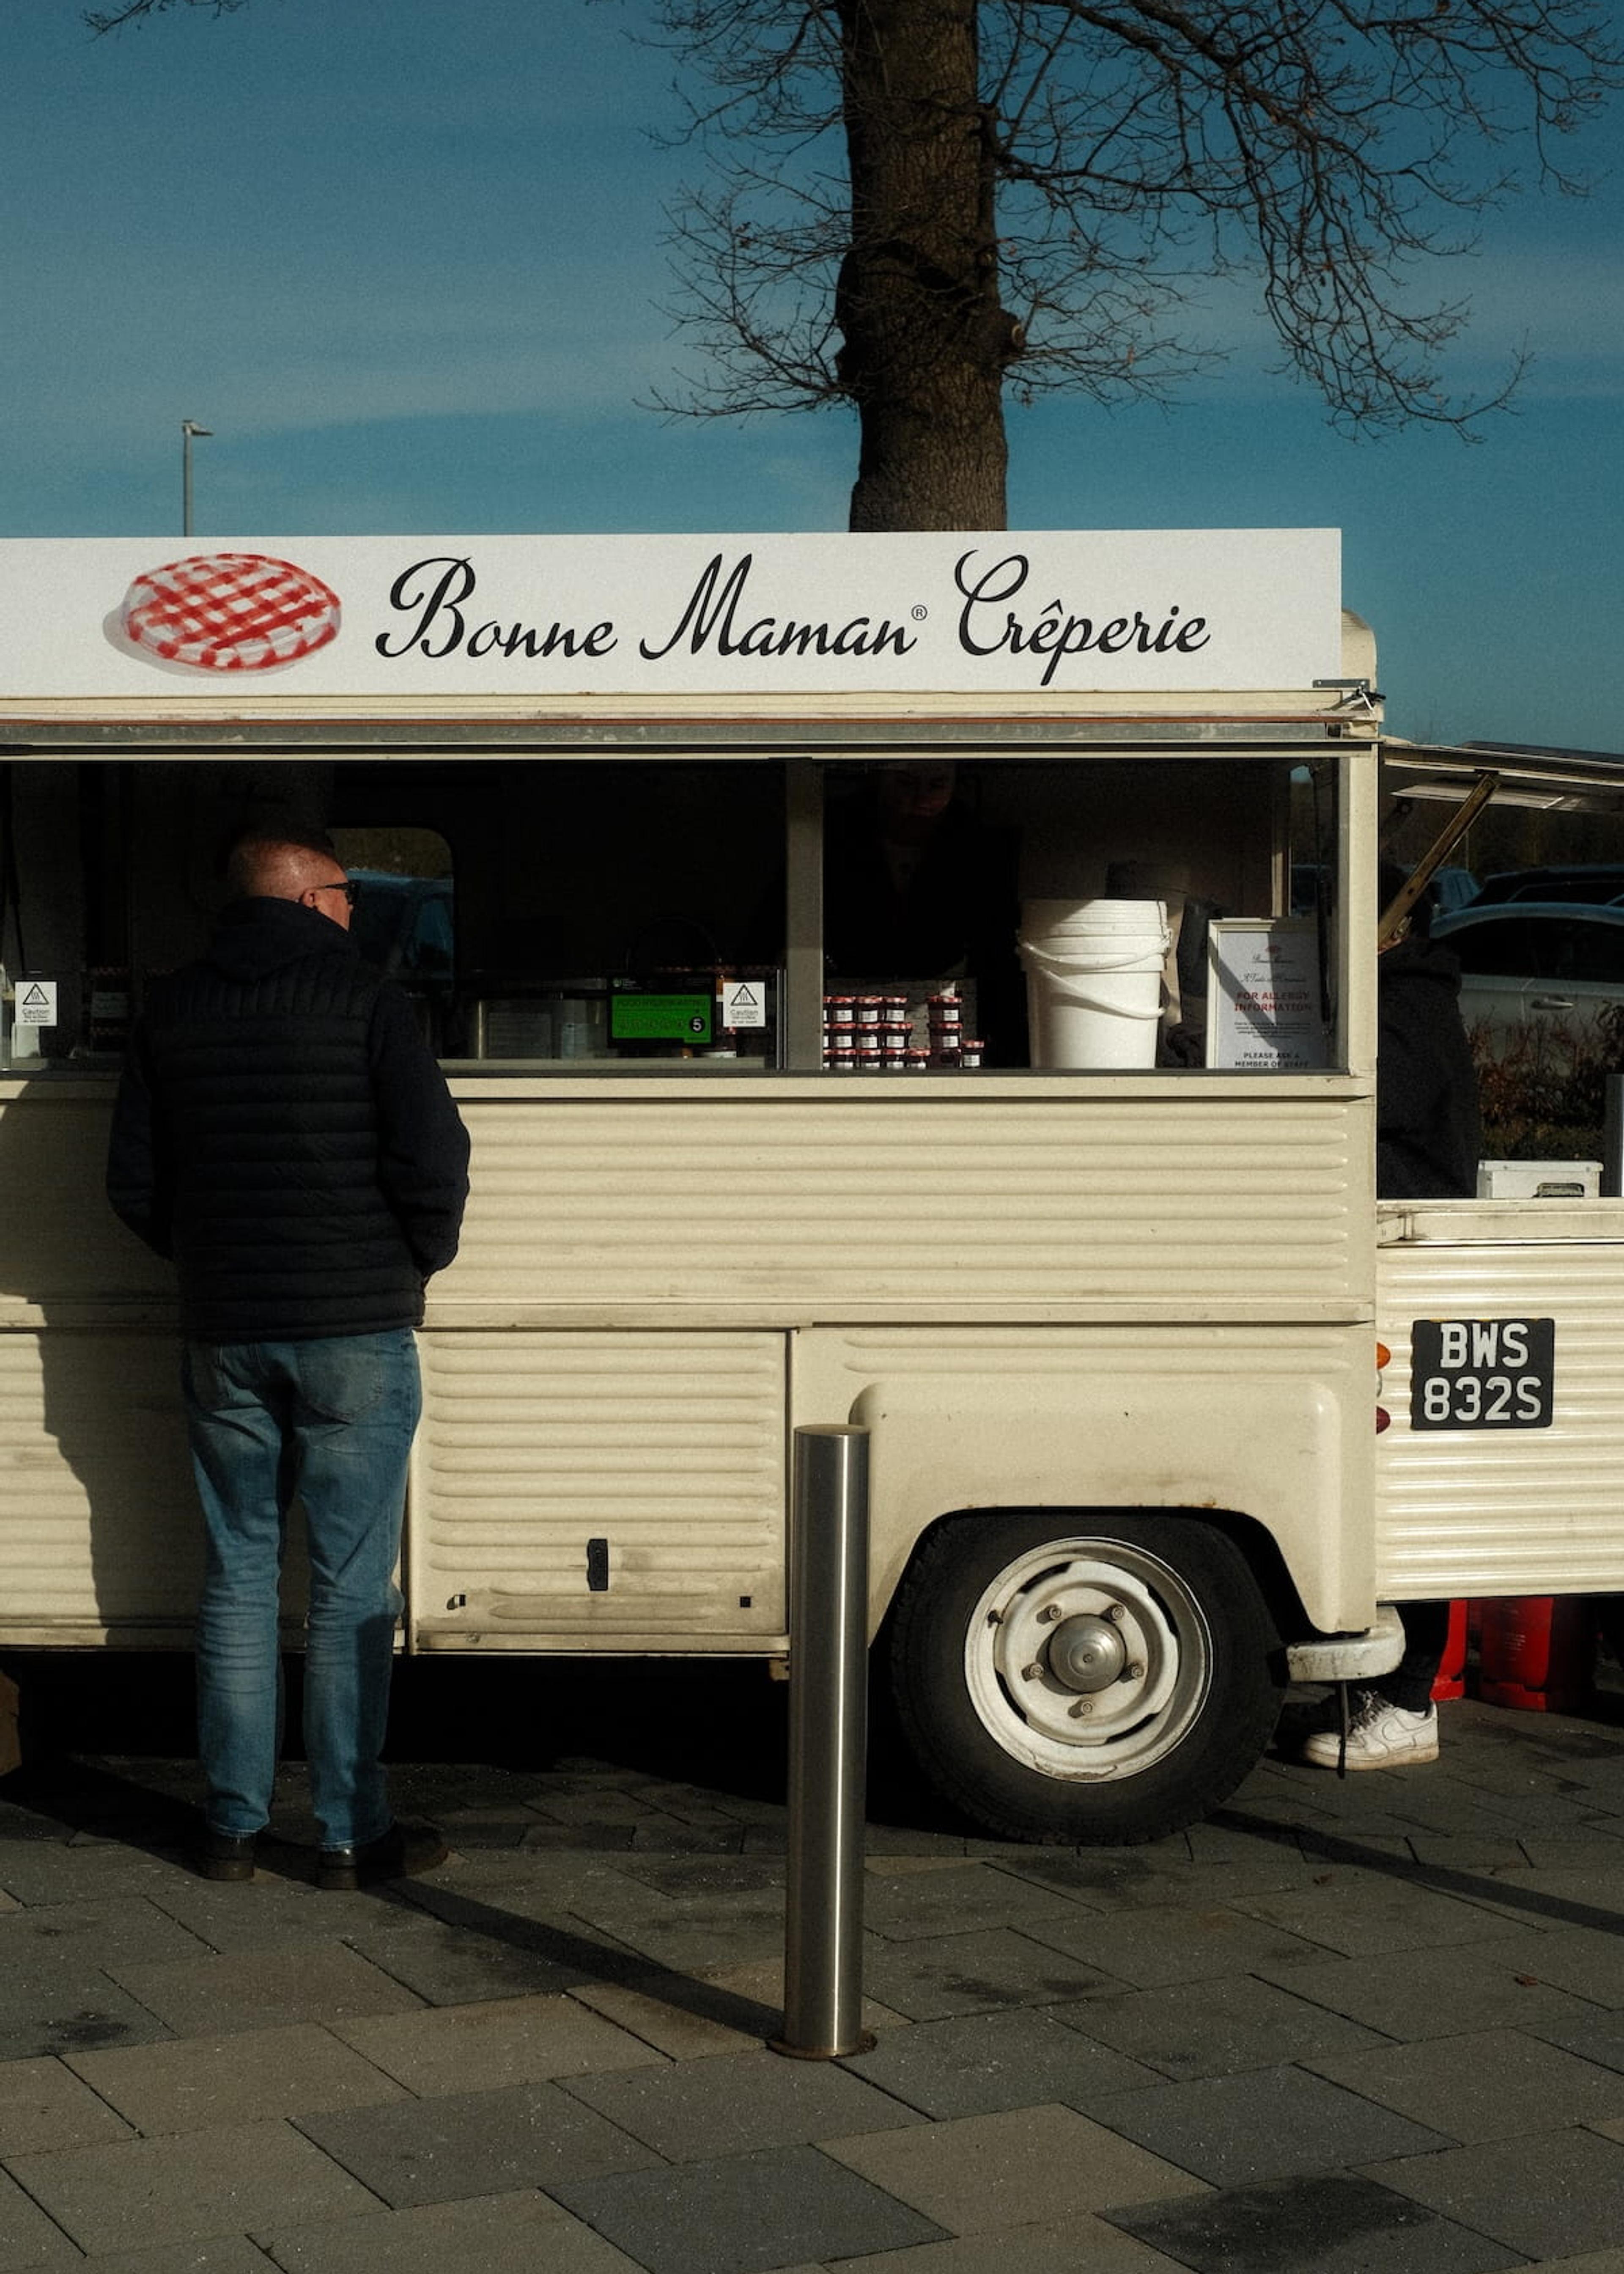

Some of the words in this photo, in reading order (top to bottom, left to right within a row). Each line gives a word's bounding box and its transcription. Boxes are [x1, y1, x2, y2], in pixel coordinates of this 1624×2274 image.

[375, 557, 618, 659] Bonne
[954, 549, 1211, 686] Crêperie
[693, 1019, 702, 1031] 5
[1440, 1323, 1528, 1368] BWS
[1424, 1376, 1542, 1421] 832S
